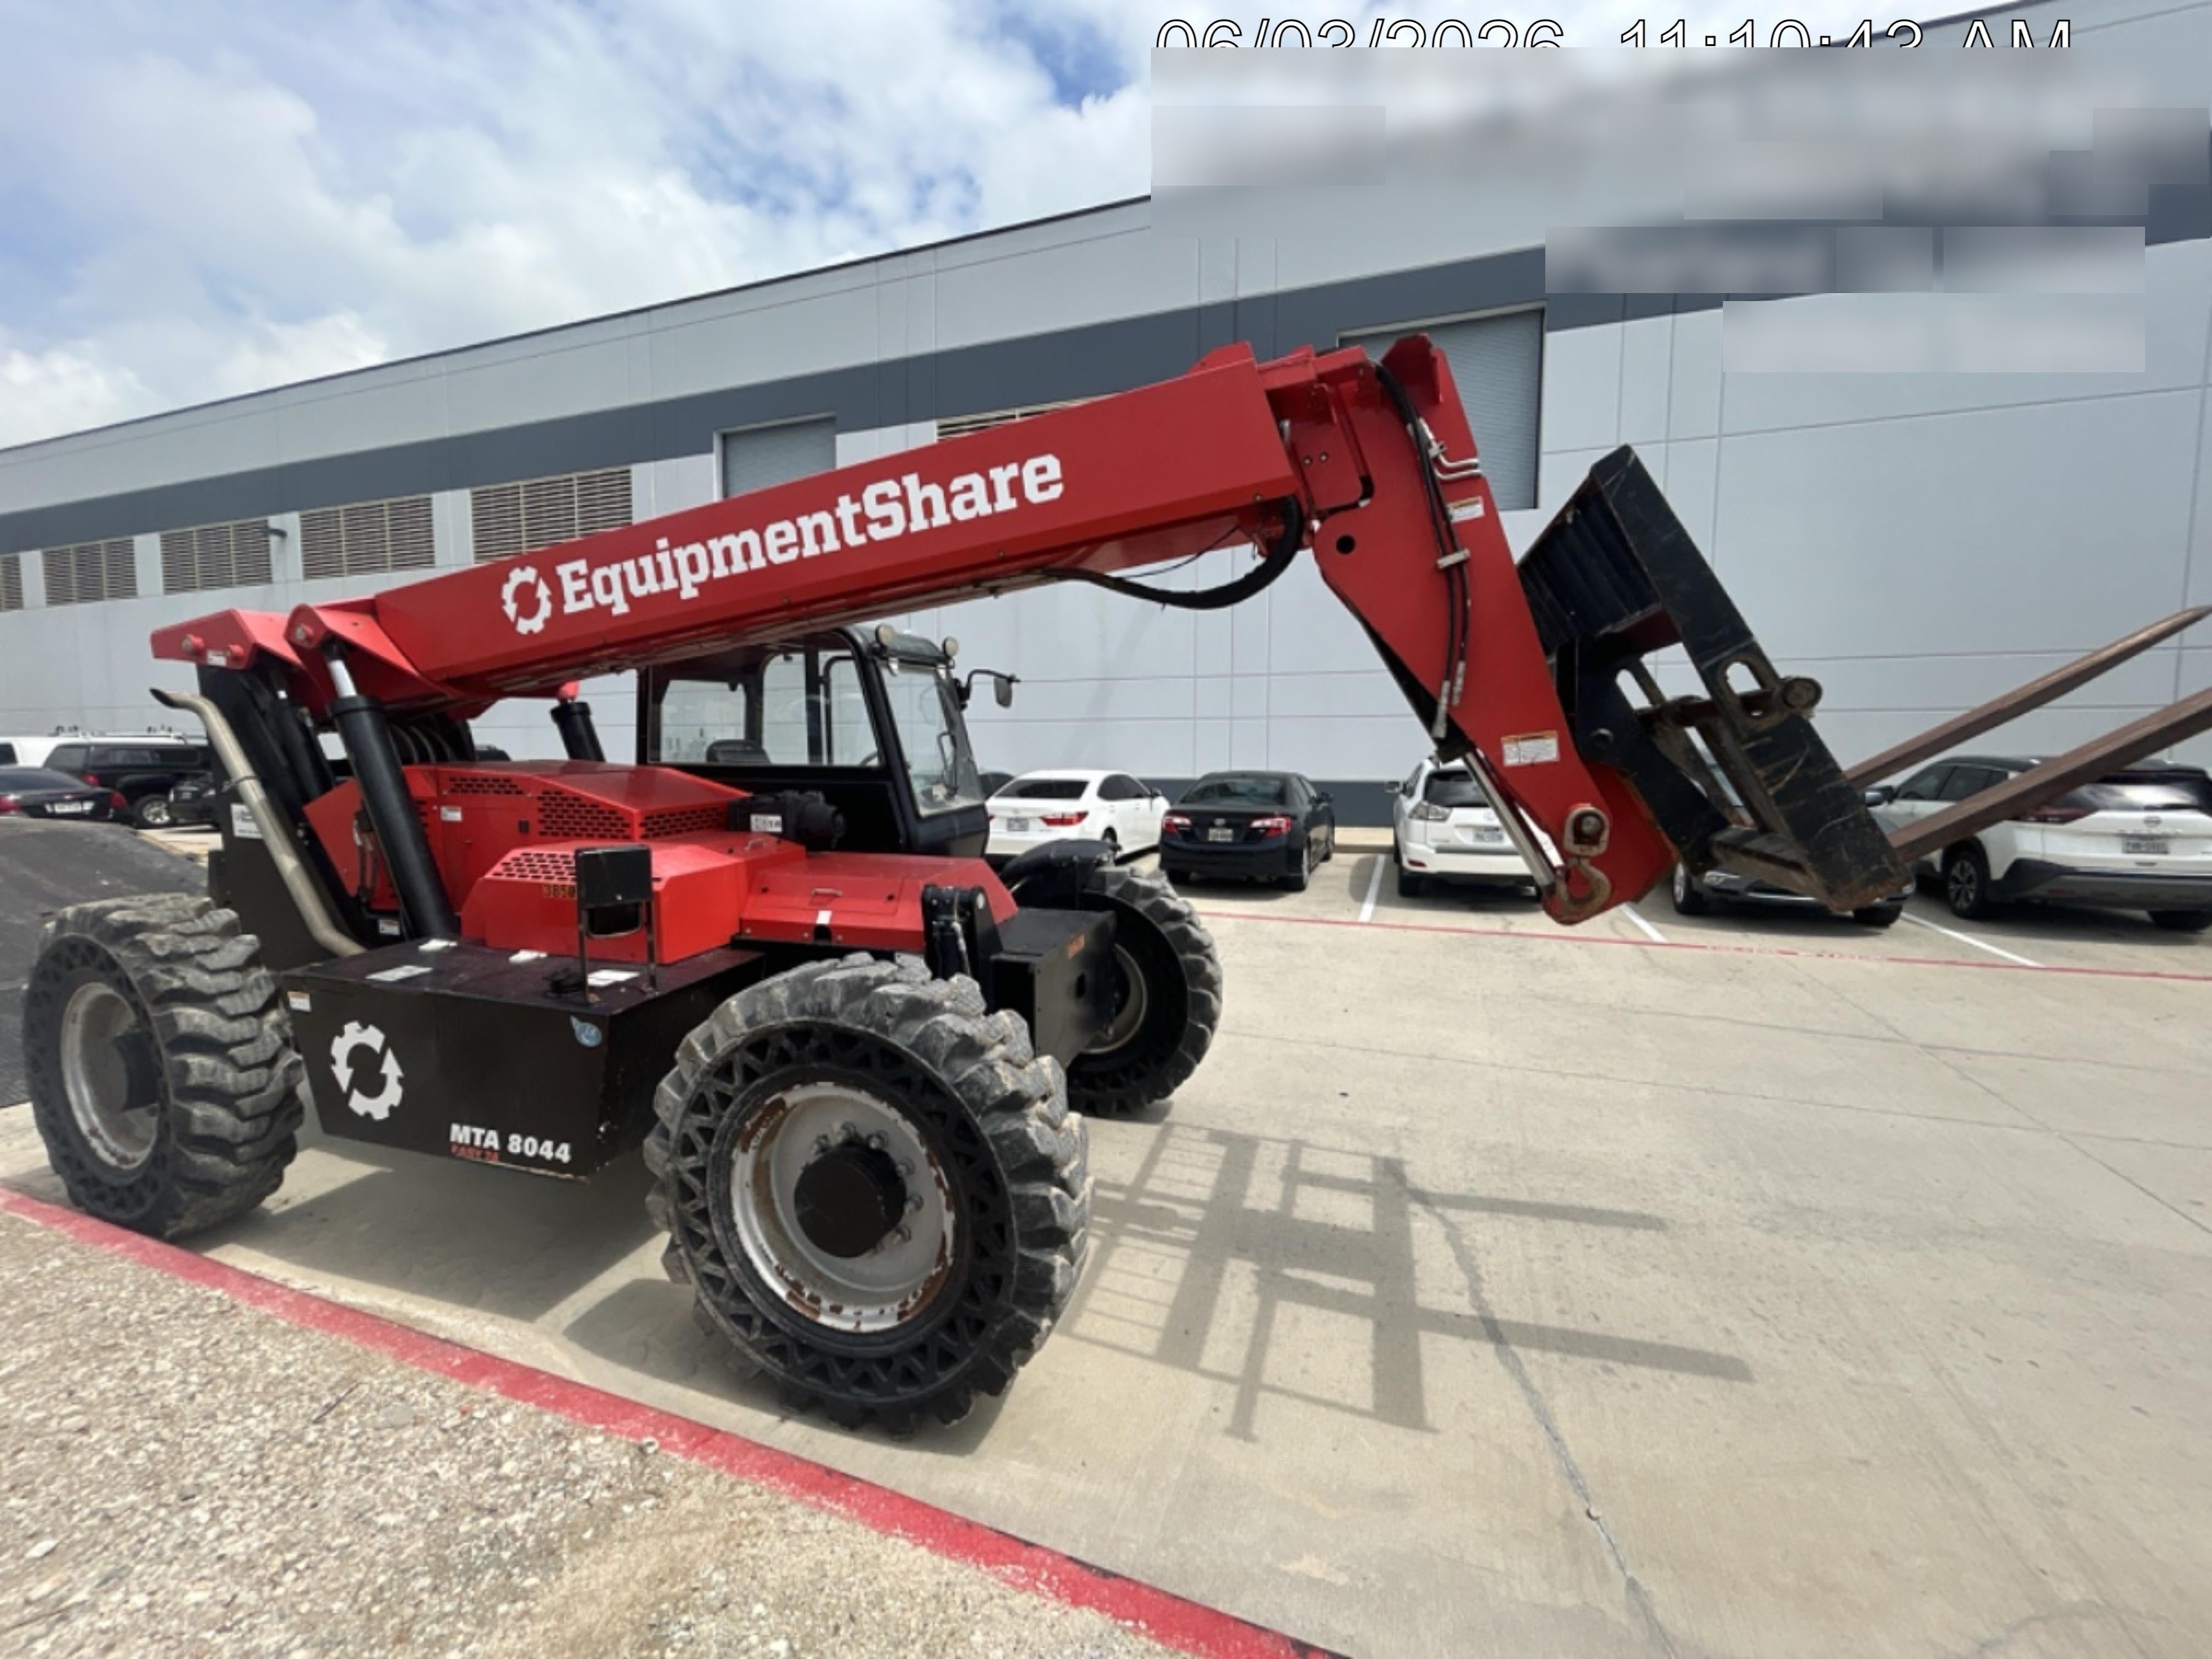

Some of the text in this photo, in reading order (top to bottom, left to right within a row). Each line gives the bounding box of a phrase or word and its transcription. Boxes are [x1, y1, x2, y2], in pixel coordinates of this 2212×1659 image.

[556, 453, 1064, 617] EquipmentShare
[449, 1123, 500, 1151] MTA
[508, 1133, 571, 1164] 8044
